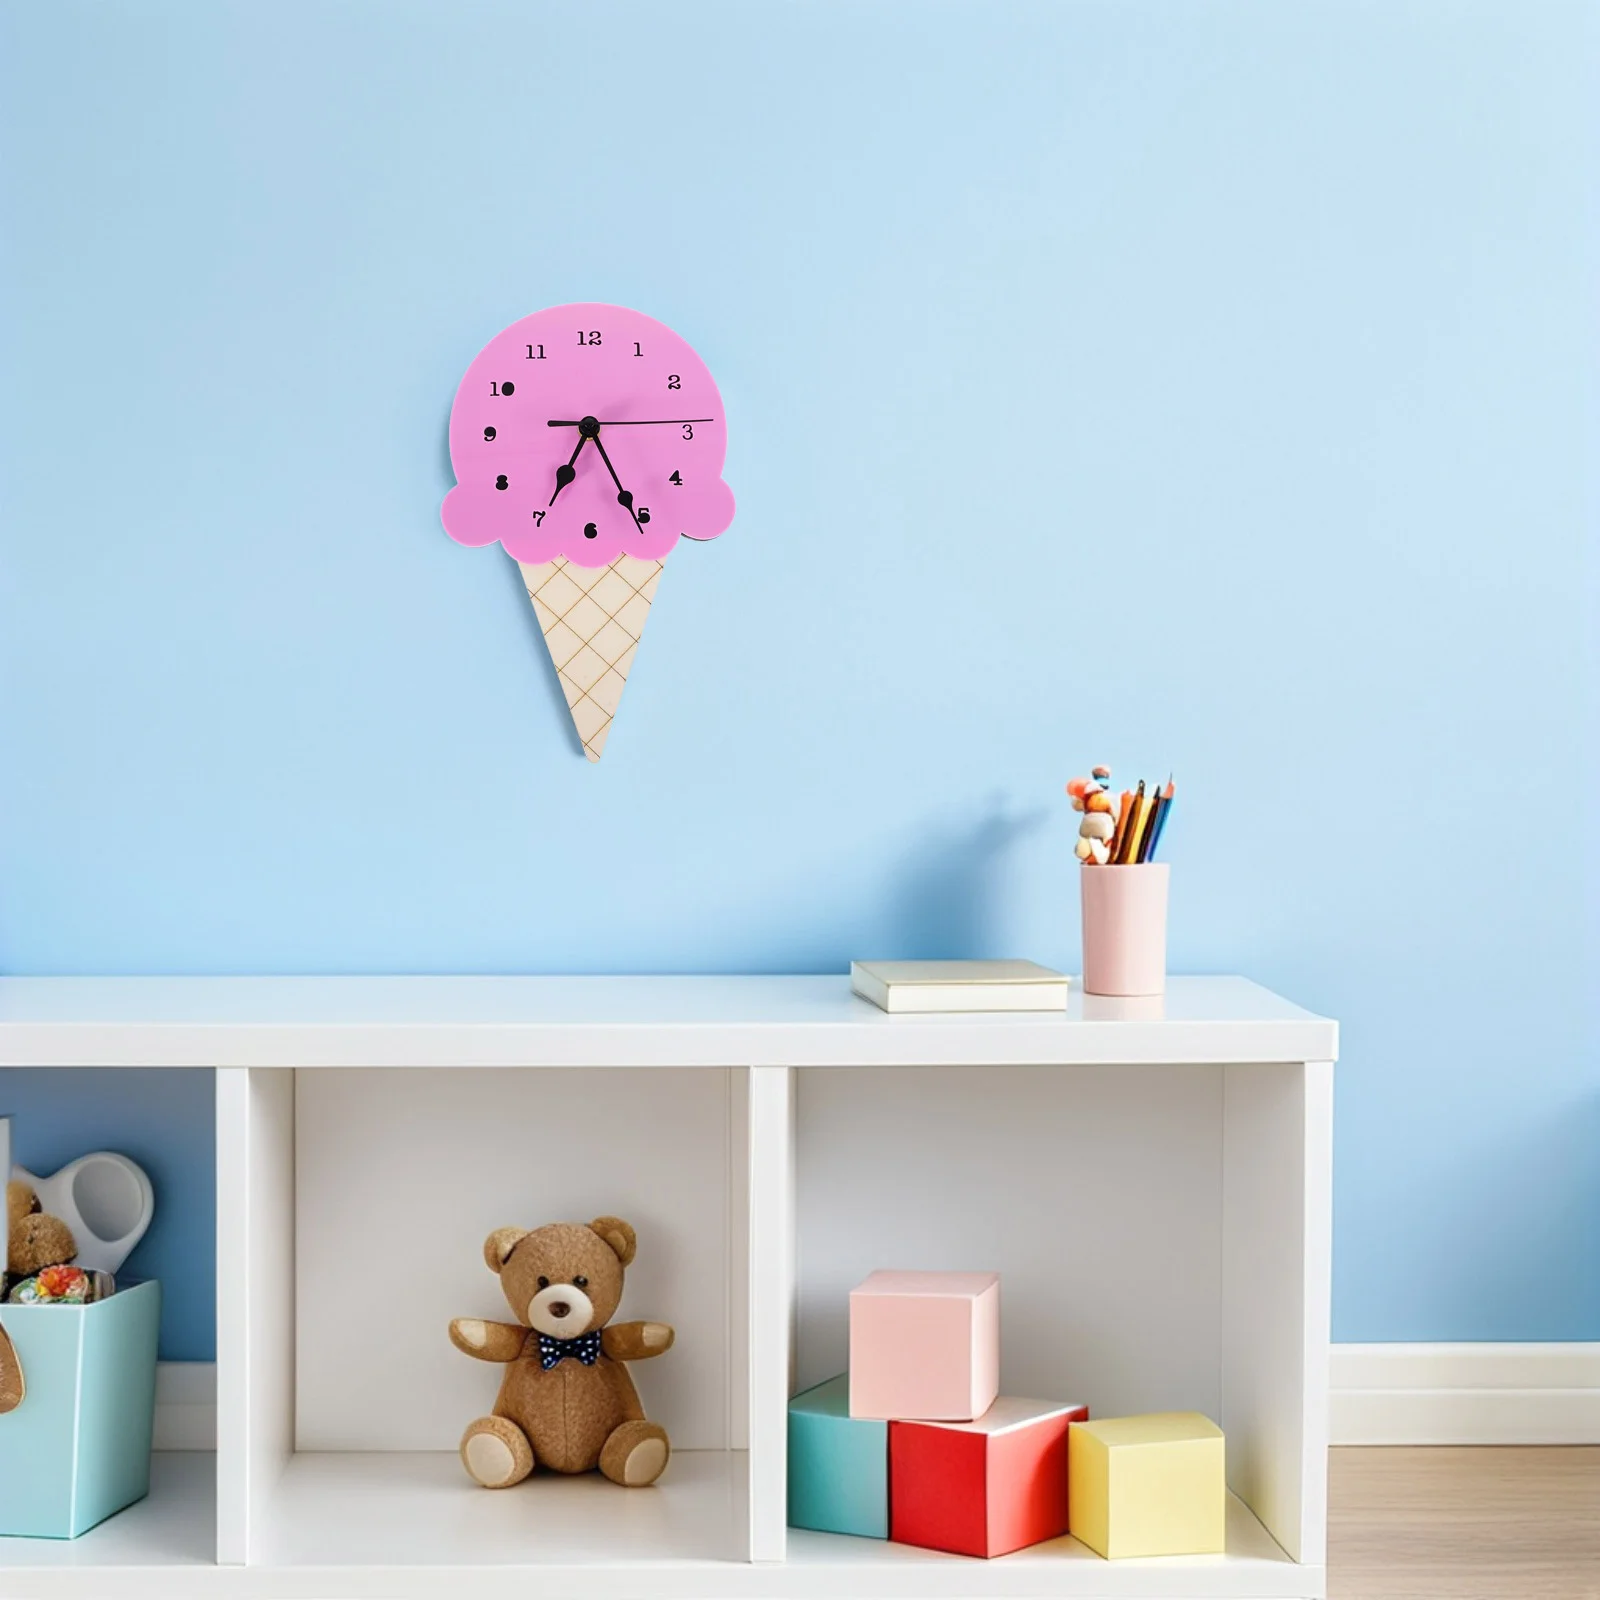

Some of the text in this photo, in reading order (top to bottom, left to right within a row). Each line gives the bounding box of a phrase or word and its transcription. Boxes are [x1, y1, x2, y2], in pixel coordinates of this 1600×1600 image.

[577, 330, 602, 346] 12
[525, 344, 547, 360] 11
[633, 342, 644, 357] 1
[489, 381, 515, 397] 10
[667, 374, 682, 390] 2
[483, 426, 497, 442] 9
[682, 423, 694, 441] 3
[495, 474, 509, 491] 8
[668, 469, 683, 486] 4
[532, 510, 547, 528] 7
[637, 507, 651, 524] 5
[583, 522, 598, 540] 6
